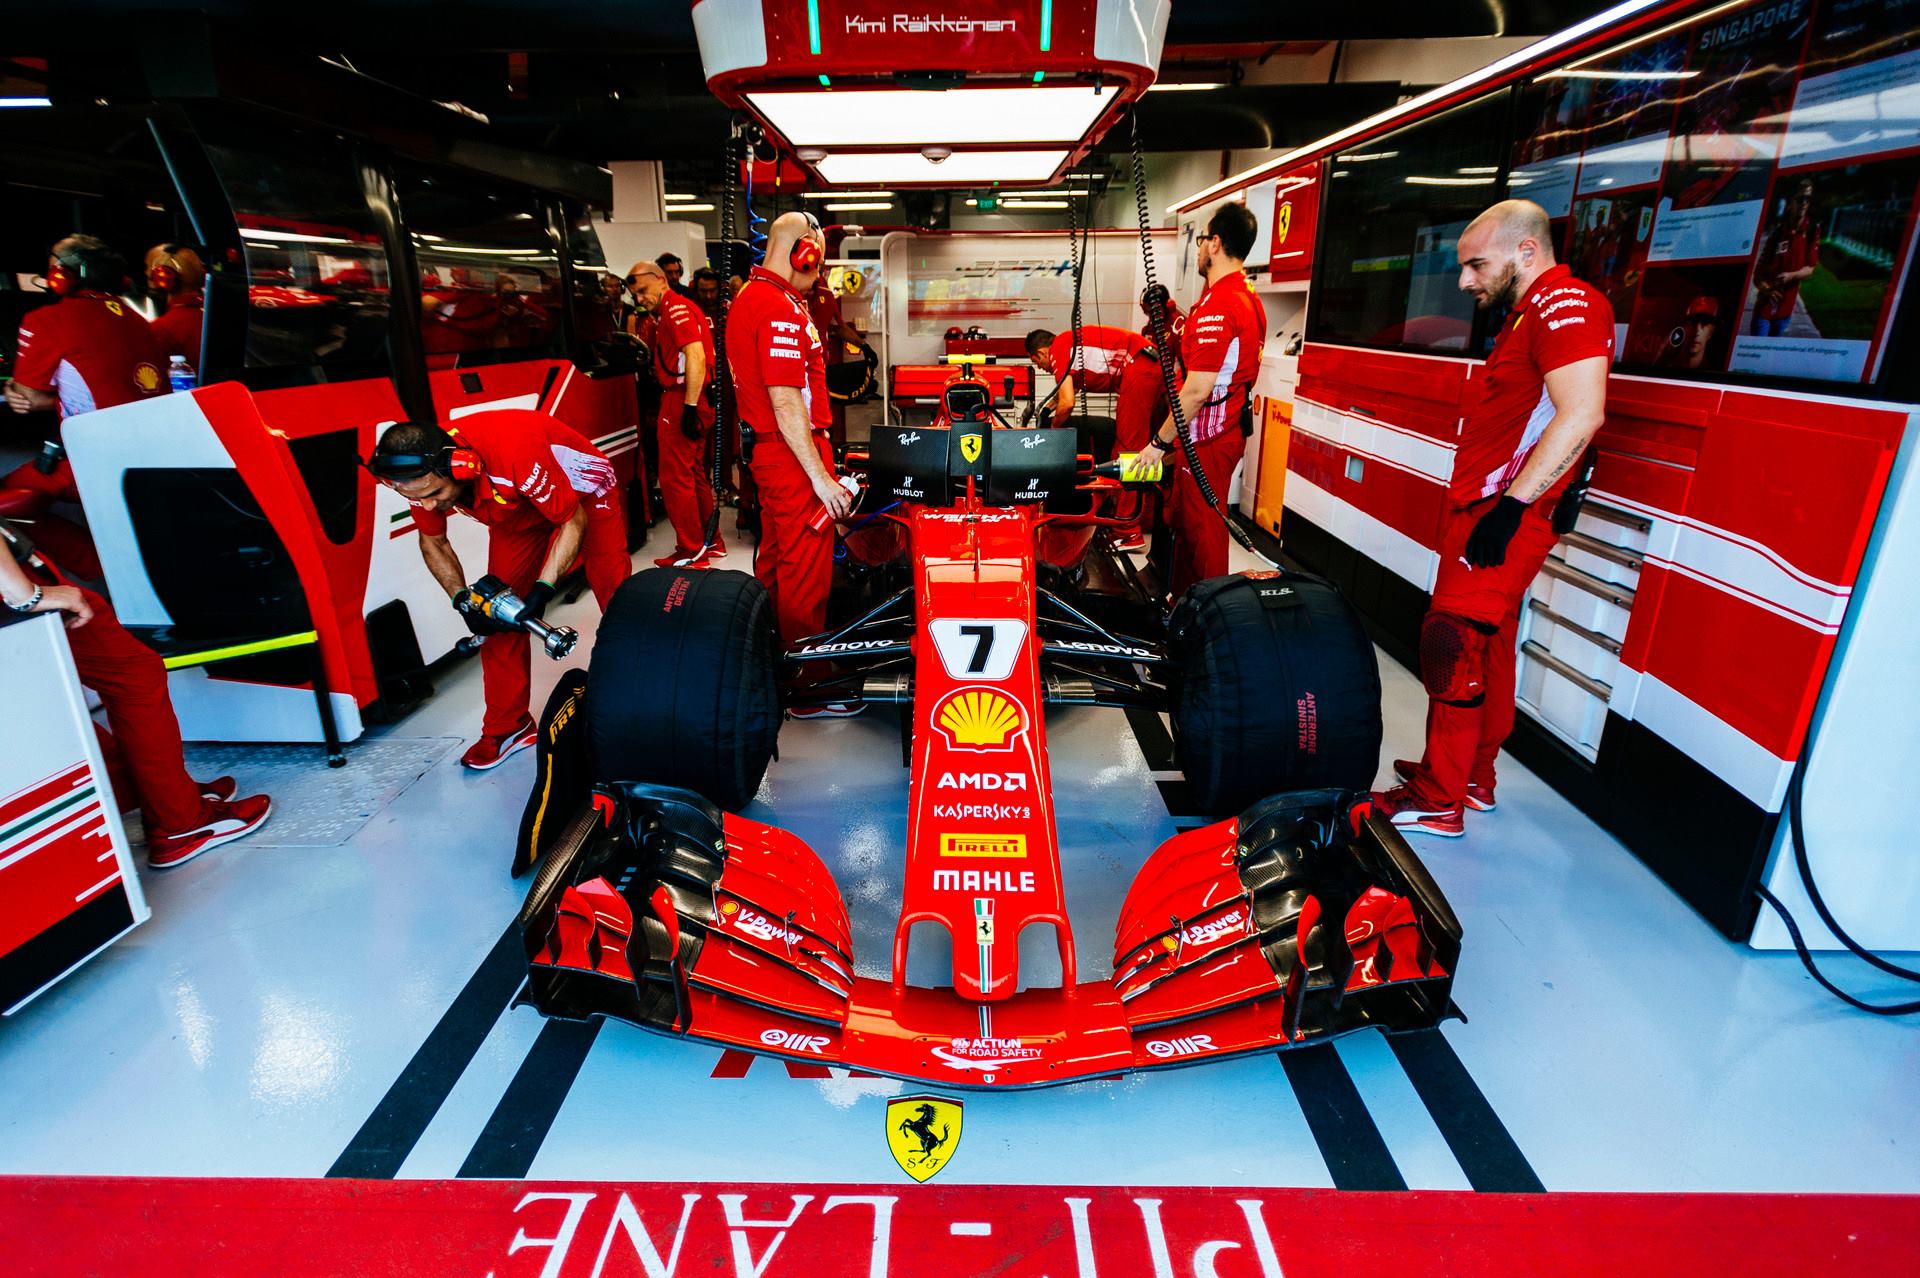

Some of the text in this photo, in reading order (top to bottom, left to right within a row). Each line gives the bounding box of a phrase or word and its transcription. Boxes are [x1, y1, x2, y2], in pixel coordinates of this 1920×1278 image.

[846, 14, 1016, 33] Kimi Räikkönen
[1701, 1, 1801, 49] SINGAPORE
[980, 199, 994, 208] EXIT
[773, 335, 799, 347] MAHLE
[519, 462, 542, 493] HUBLOT
[893, 488, 924, 498] HUBLOT
[1014, 491, 1049, 500] HUBLOT
[801, 639, 894, 655] Lenovo
[958, 623, 997, 675] 7
[1055, 639, 1150, 657] Lenovo
[1297, 698, 1308, 750] SINISTRA
[1305, 691, 1317, 755] ANTERIORE
[937, 772, 1003, 790] AMD
[933, 802, 1022, 821] KASPERSKY
[947, 838, 1019, 853] PIRELLI
[933, 869, 1036, 893] MAHLE
[737, 907, 805, 946] V-Power
[1175, 909, 1243, 945] V-Power
[969, 1048, 999, 1057] ROAD
[1001, 1048, 1042, 1057] SAFETY
[972, 1038, 1021, 1049] ACTION
[484, 1191, 900, 1278] LANE
